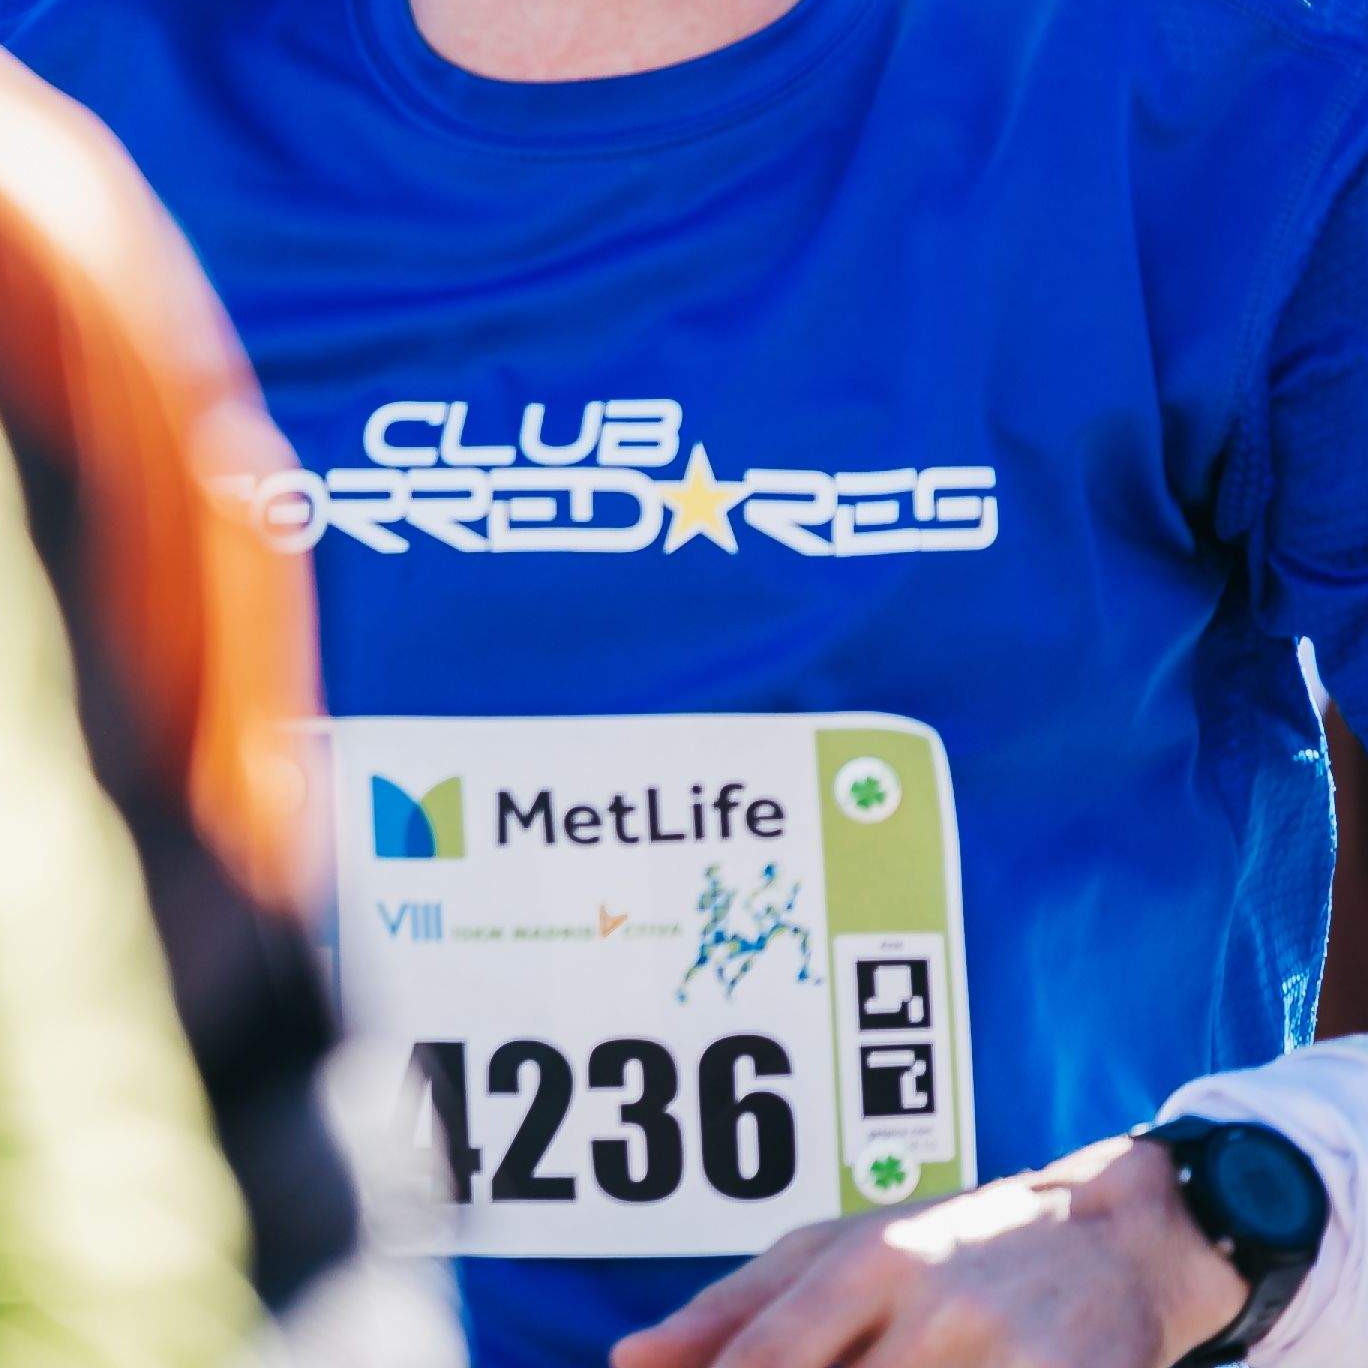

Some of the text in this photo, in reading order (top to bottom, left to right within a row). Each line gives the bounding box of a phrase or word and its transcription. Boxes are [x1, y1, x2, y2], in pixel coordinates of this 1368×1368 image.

[363, 398, 683, 468] CLUB
[495, 782, 787, 848] MetLife
[375, 900, 443, 942] VIII
[400, 1033, 797, 1204] 4236
